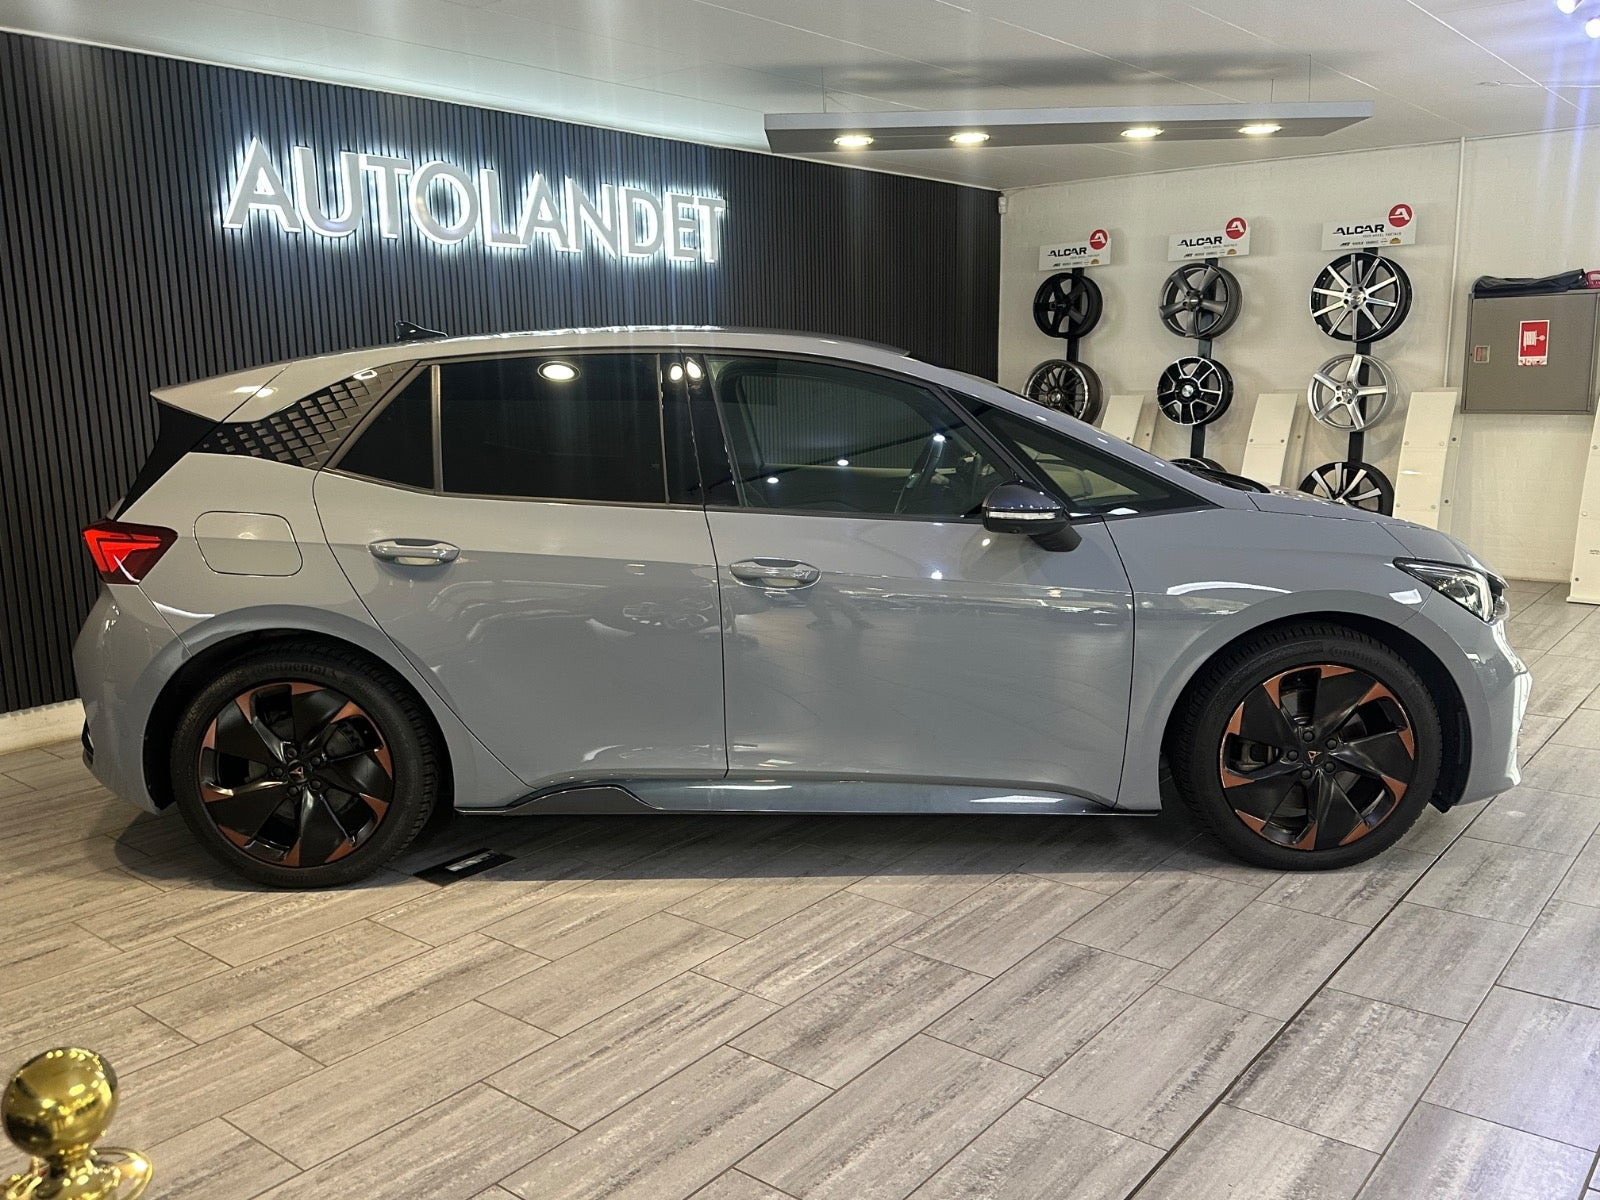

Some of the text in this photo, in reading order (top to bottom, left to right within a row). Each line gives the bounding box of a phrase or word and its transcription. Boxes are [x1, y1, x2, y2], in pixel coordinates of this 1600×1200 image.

[223, 136, 725, 263] AUTOLANDET
[1332, 223, 1385, 236] ALCAR
[1177, 236, 1223, 247] ALCAR
[1047, 247, 1087, 257] ALCAR
